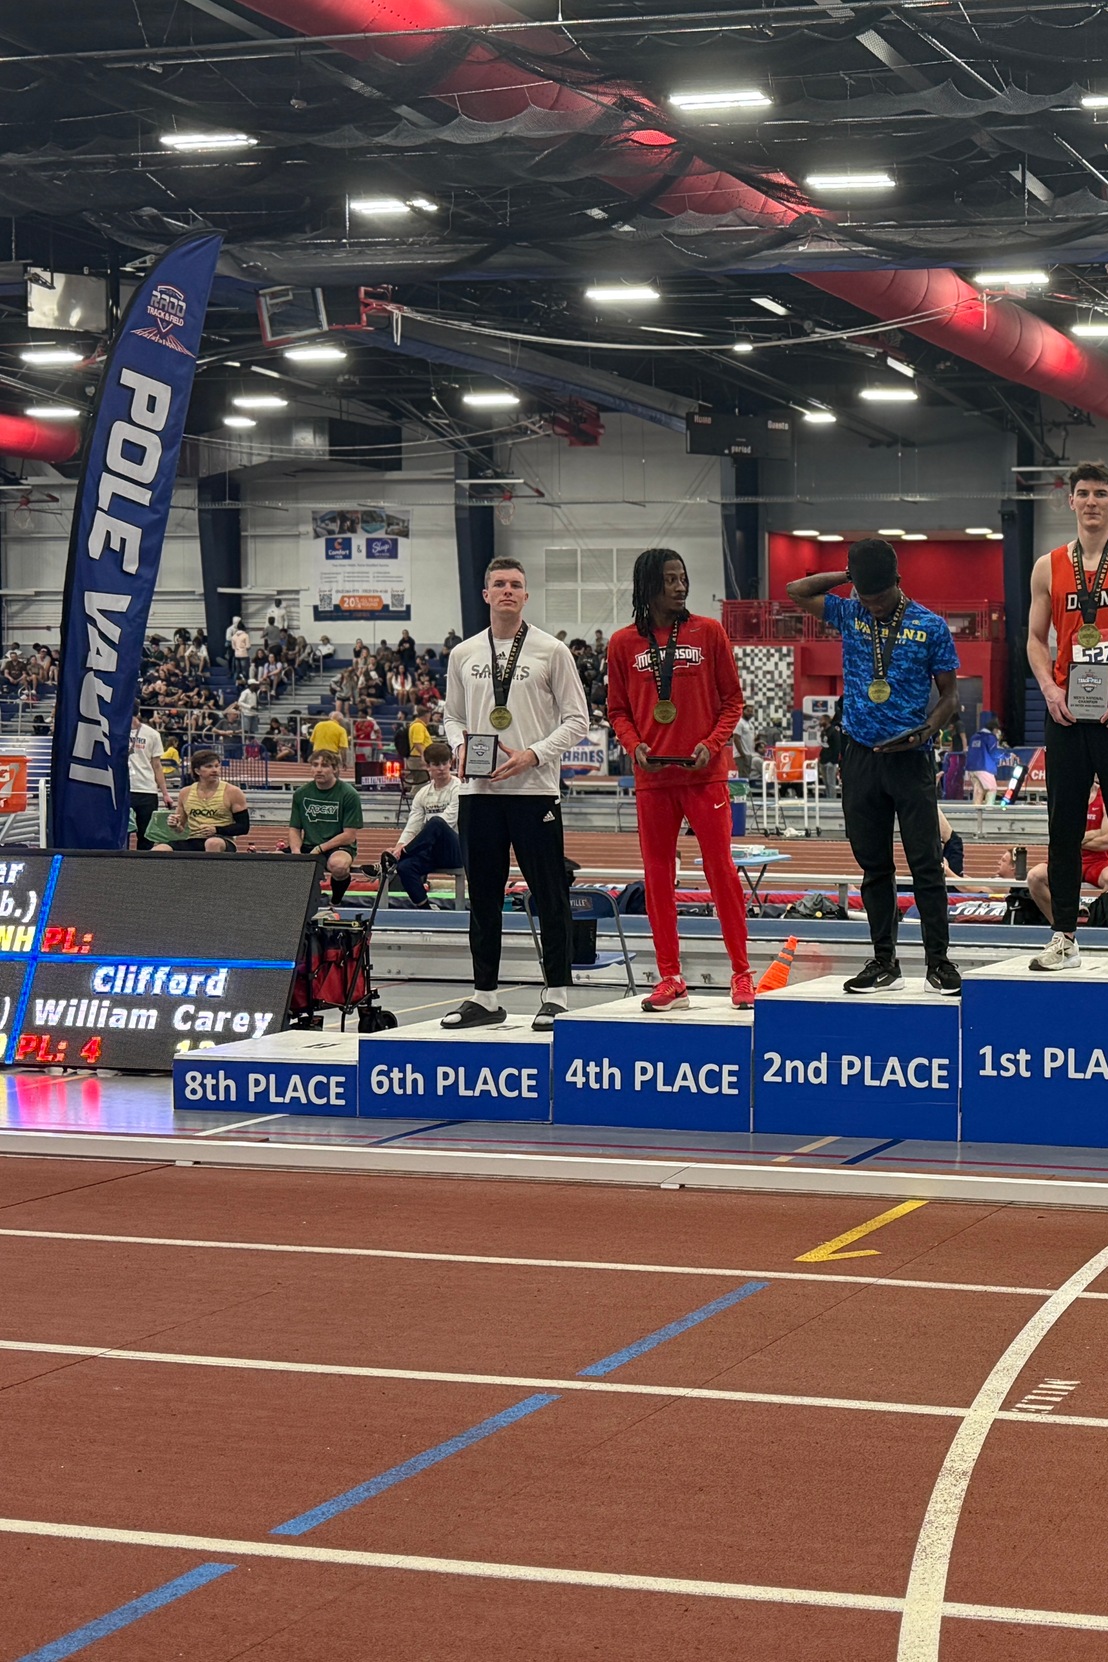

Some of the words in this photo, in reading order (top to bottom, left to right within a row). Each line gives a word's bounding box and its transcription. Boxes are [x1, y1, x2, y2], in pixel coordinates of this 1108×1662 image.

[147, 305, 166, 319] TRACK
[170, 314, 184, 327] FIELD
[88, 367, 172, 575] POLE
[68, 591, 134, 811] VAULT
[188, 808, 218, 817] ROCKY
[308, 804, 340, 816] ROCKY
[41, 926, 94, 954] PL:
[93, 965, 229, 997] Clifford
[34, 998, 158, 1030] William
[173, 1004, 274, 1040] Carey
[16, 1034, 68, 1064] PL:
[80, 1036, 102, 1063] 4
[978, 1045, 1031, 1078] 1st
[370, 1063, 424, 1095] 6th
[436, 1066, 538, 1098] PLACE
[565, 1057, 621, 1090] 4th
[634, 1061, 739, 1095] PLACE
[763, 1051, 828, 1085] 2nd
[841, 1055, 950, 1089] PLACE
[184, 1070, 236, 1101] 8th
[248, 1073, 346, 1106] PLACE
